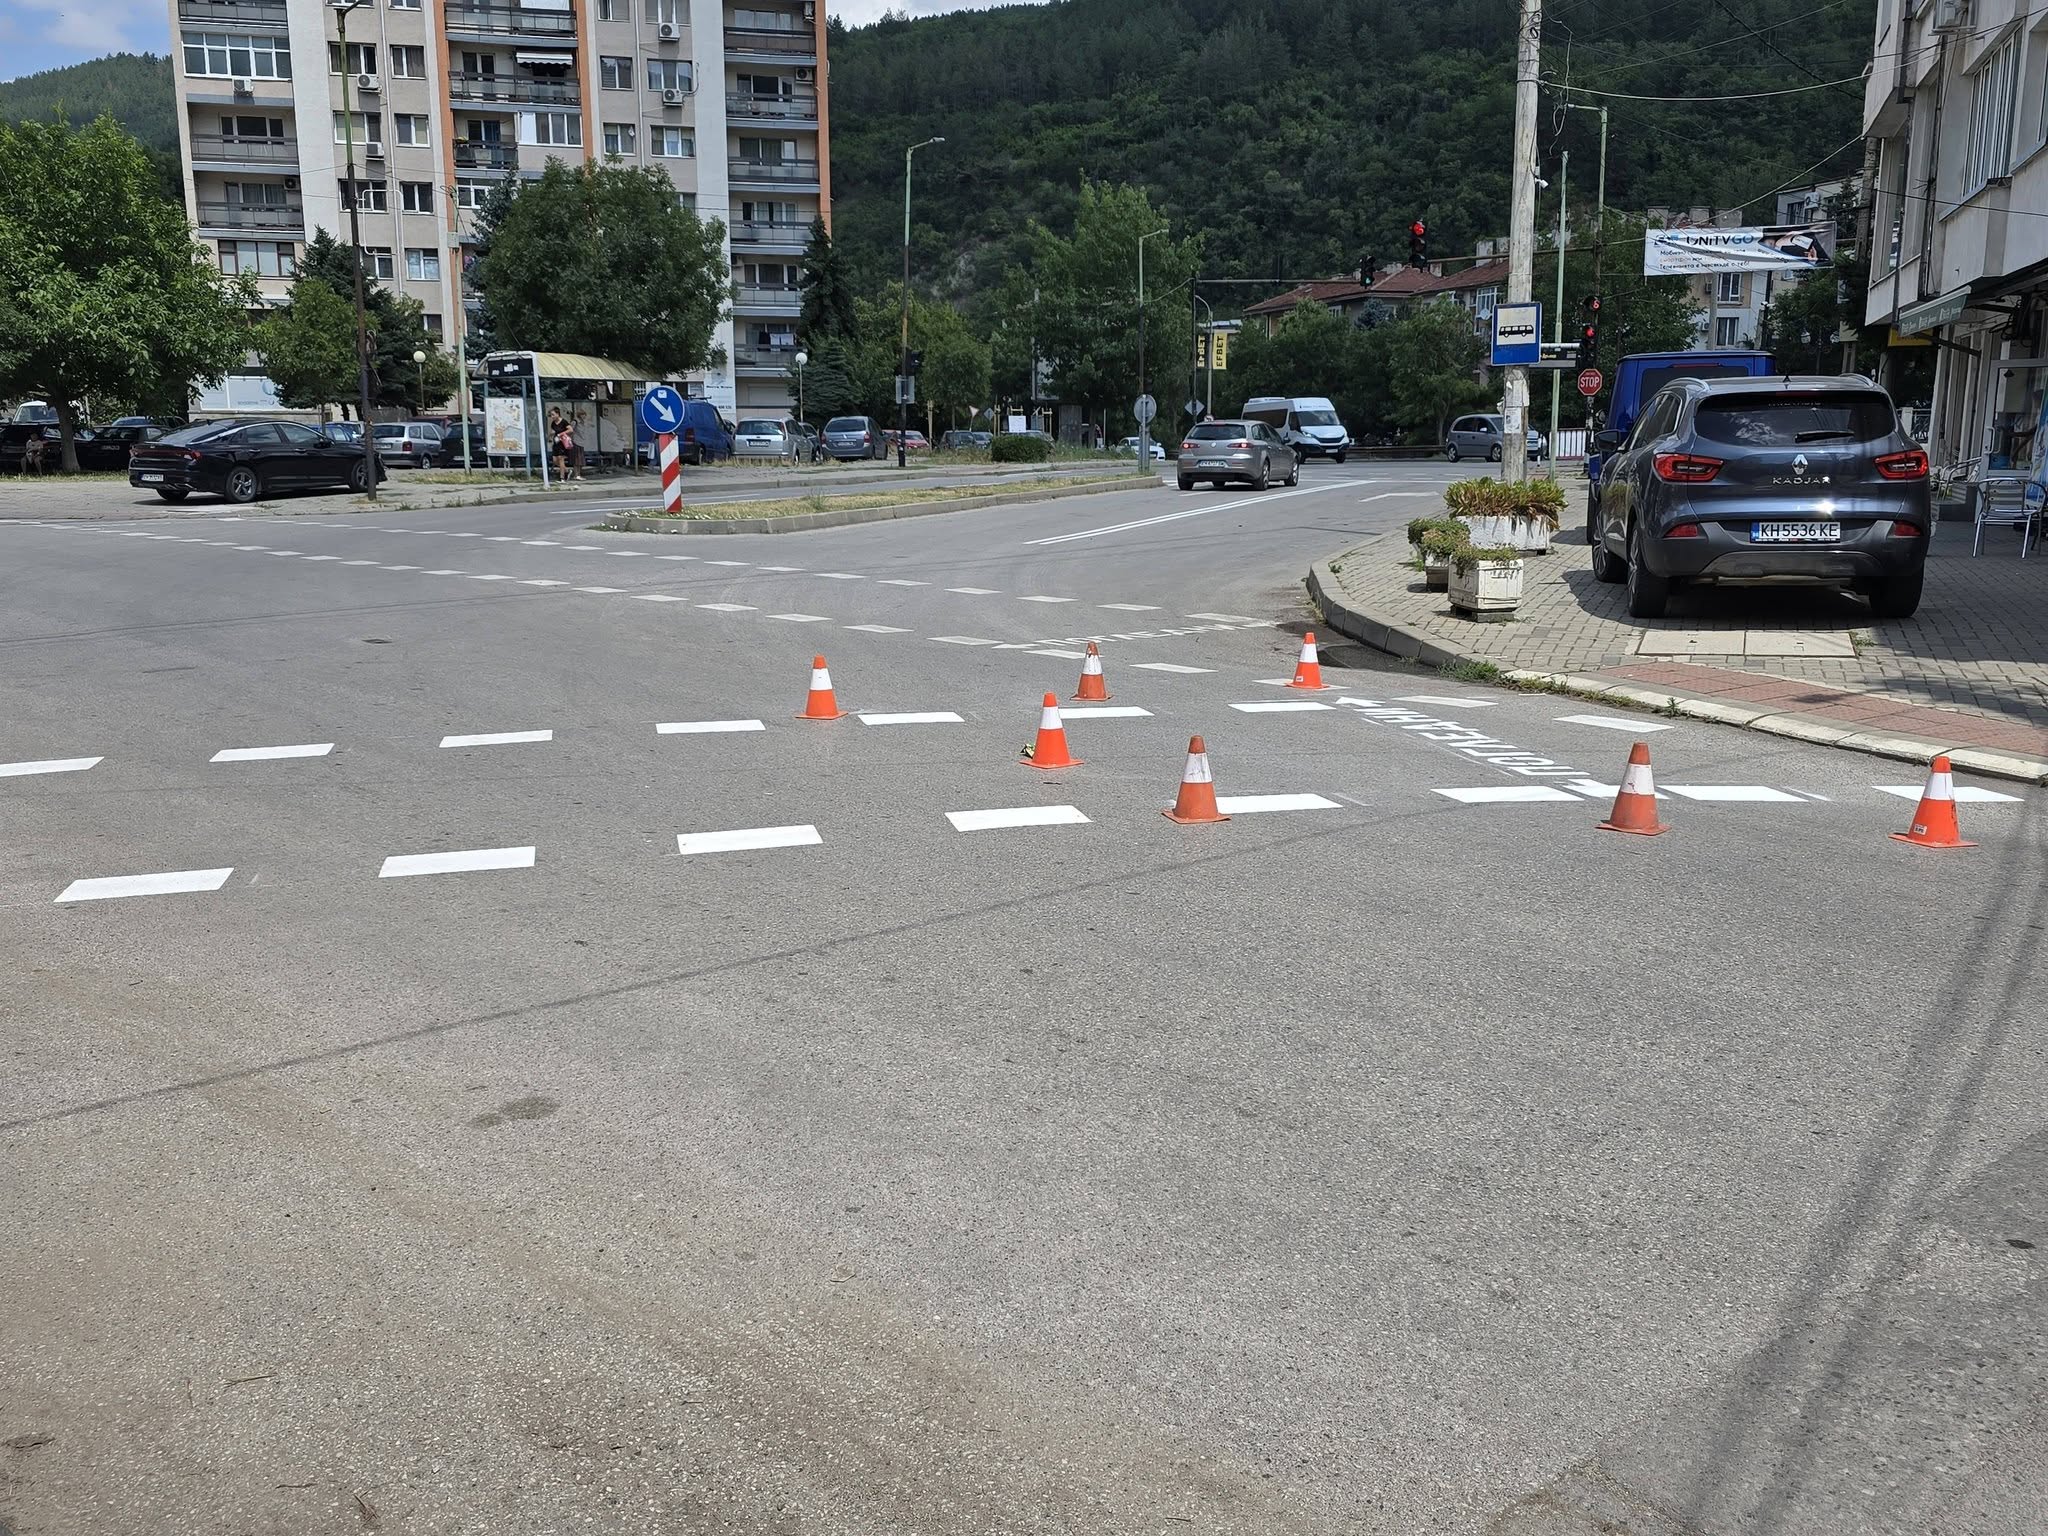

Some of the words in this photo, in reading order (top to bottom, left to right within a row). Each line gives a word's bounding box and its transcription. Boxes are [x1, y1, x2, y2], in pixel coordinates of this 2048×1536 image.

[1216, 335, 1224, 367] EFBET
[1580, 377, 1599, 387] STOP
[1773, 476, 1830, 484] KADJAR
